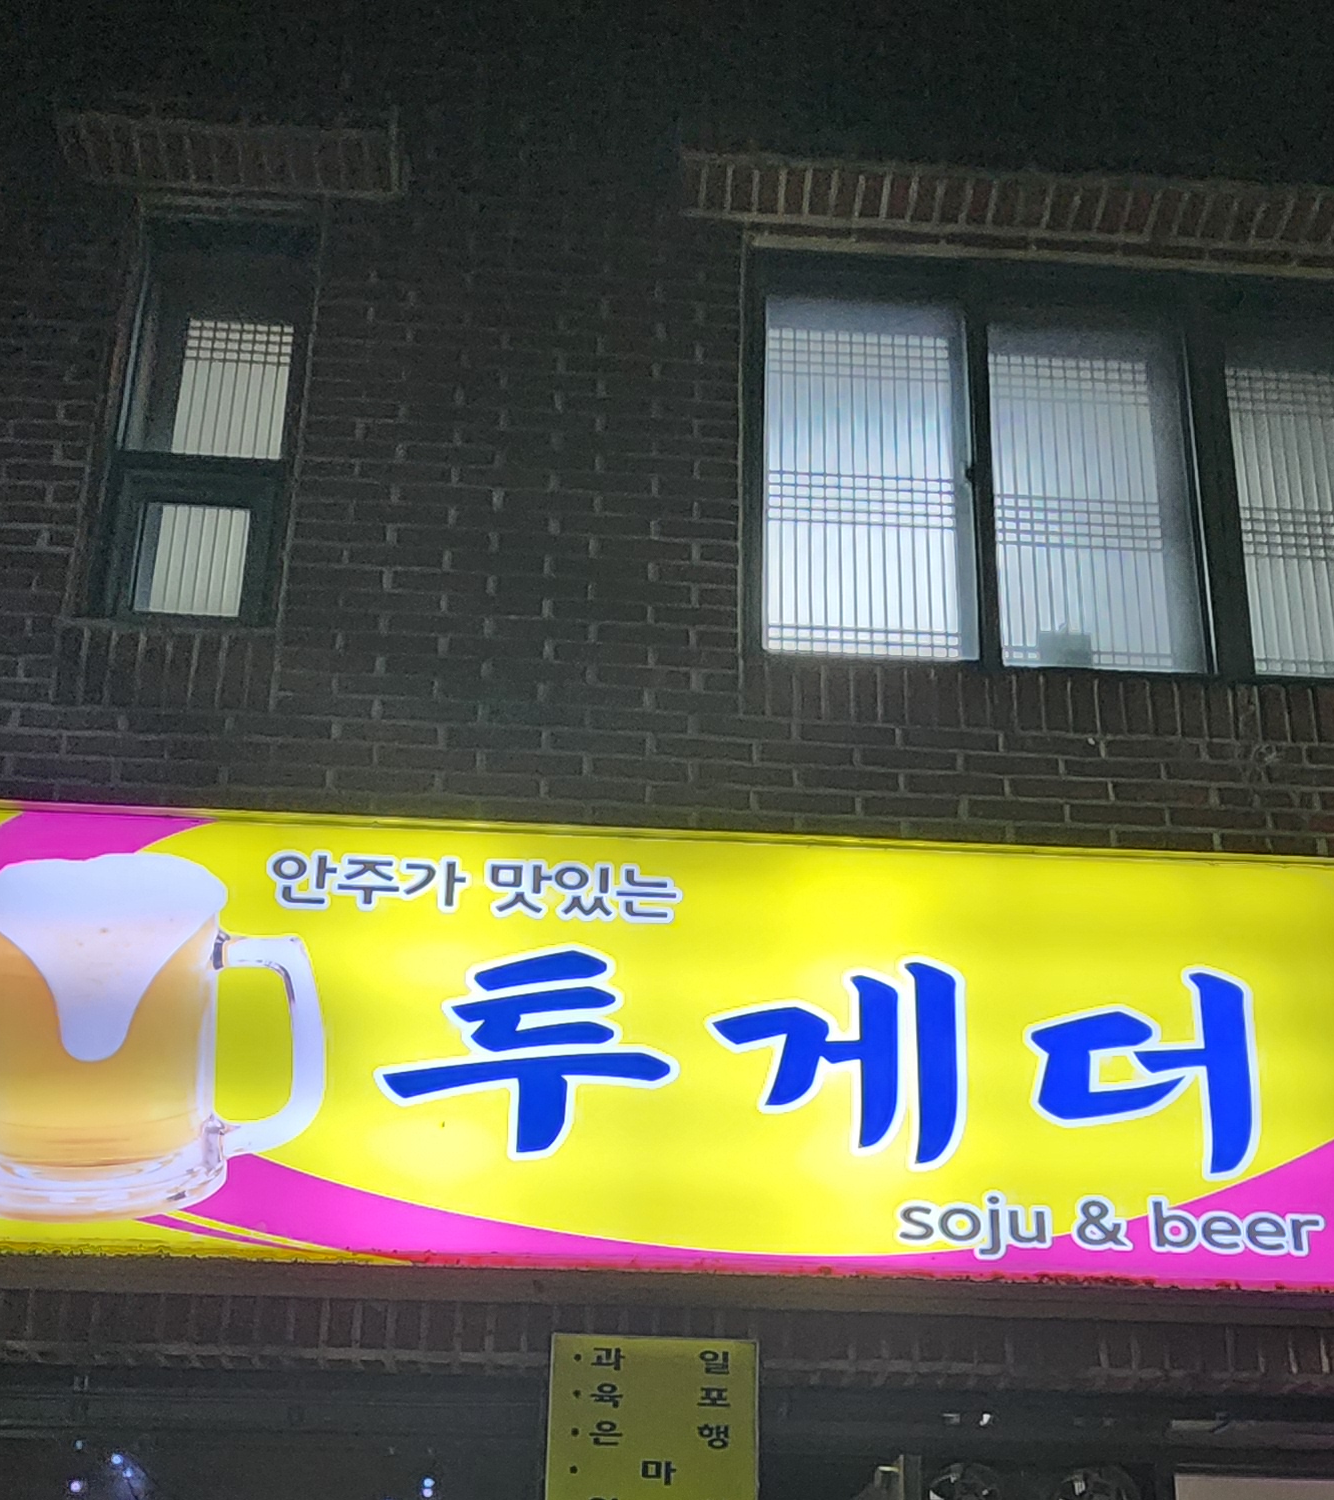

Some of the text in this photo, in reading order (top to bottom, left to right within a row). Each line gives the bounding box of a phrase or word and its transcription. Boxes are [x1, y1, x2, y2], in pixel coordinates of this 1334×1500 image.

[272, 852, 683, 920] 안주가 맛있는
[381, 948, 1258, 1177] 투게더
[898, 1196, 1325, 1259] soju & beer
